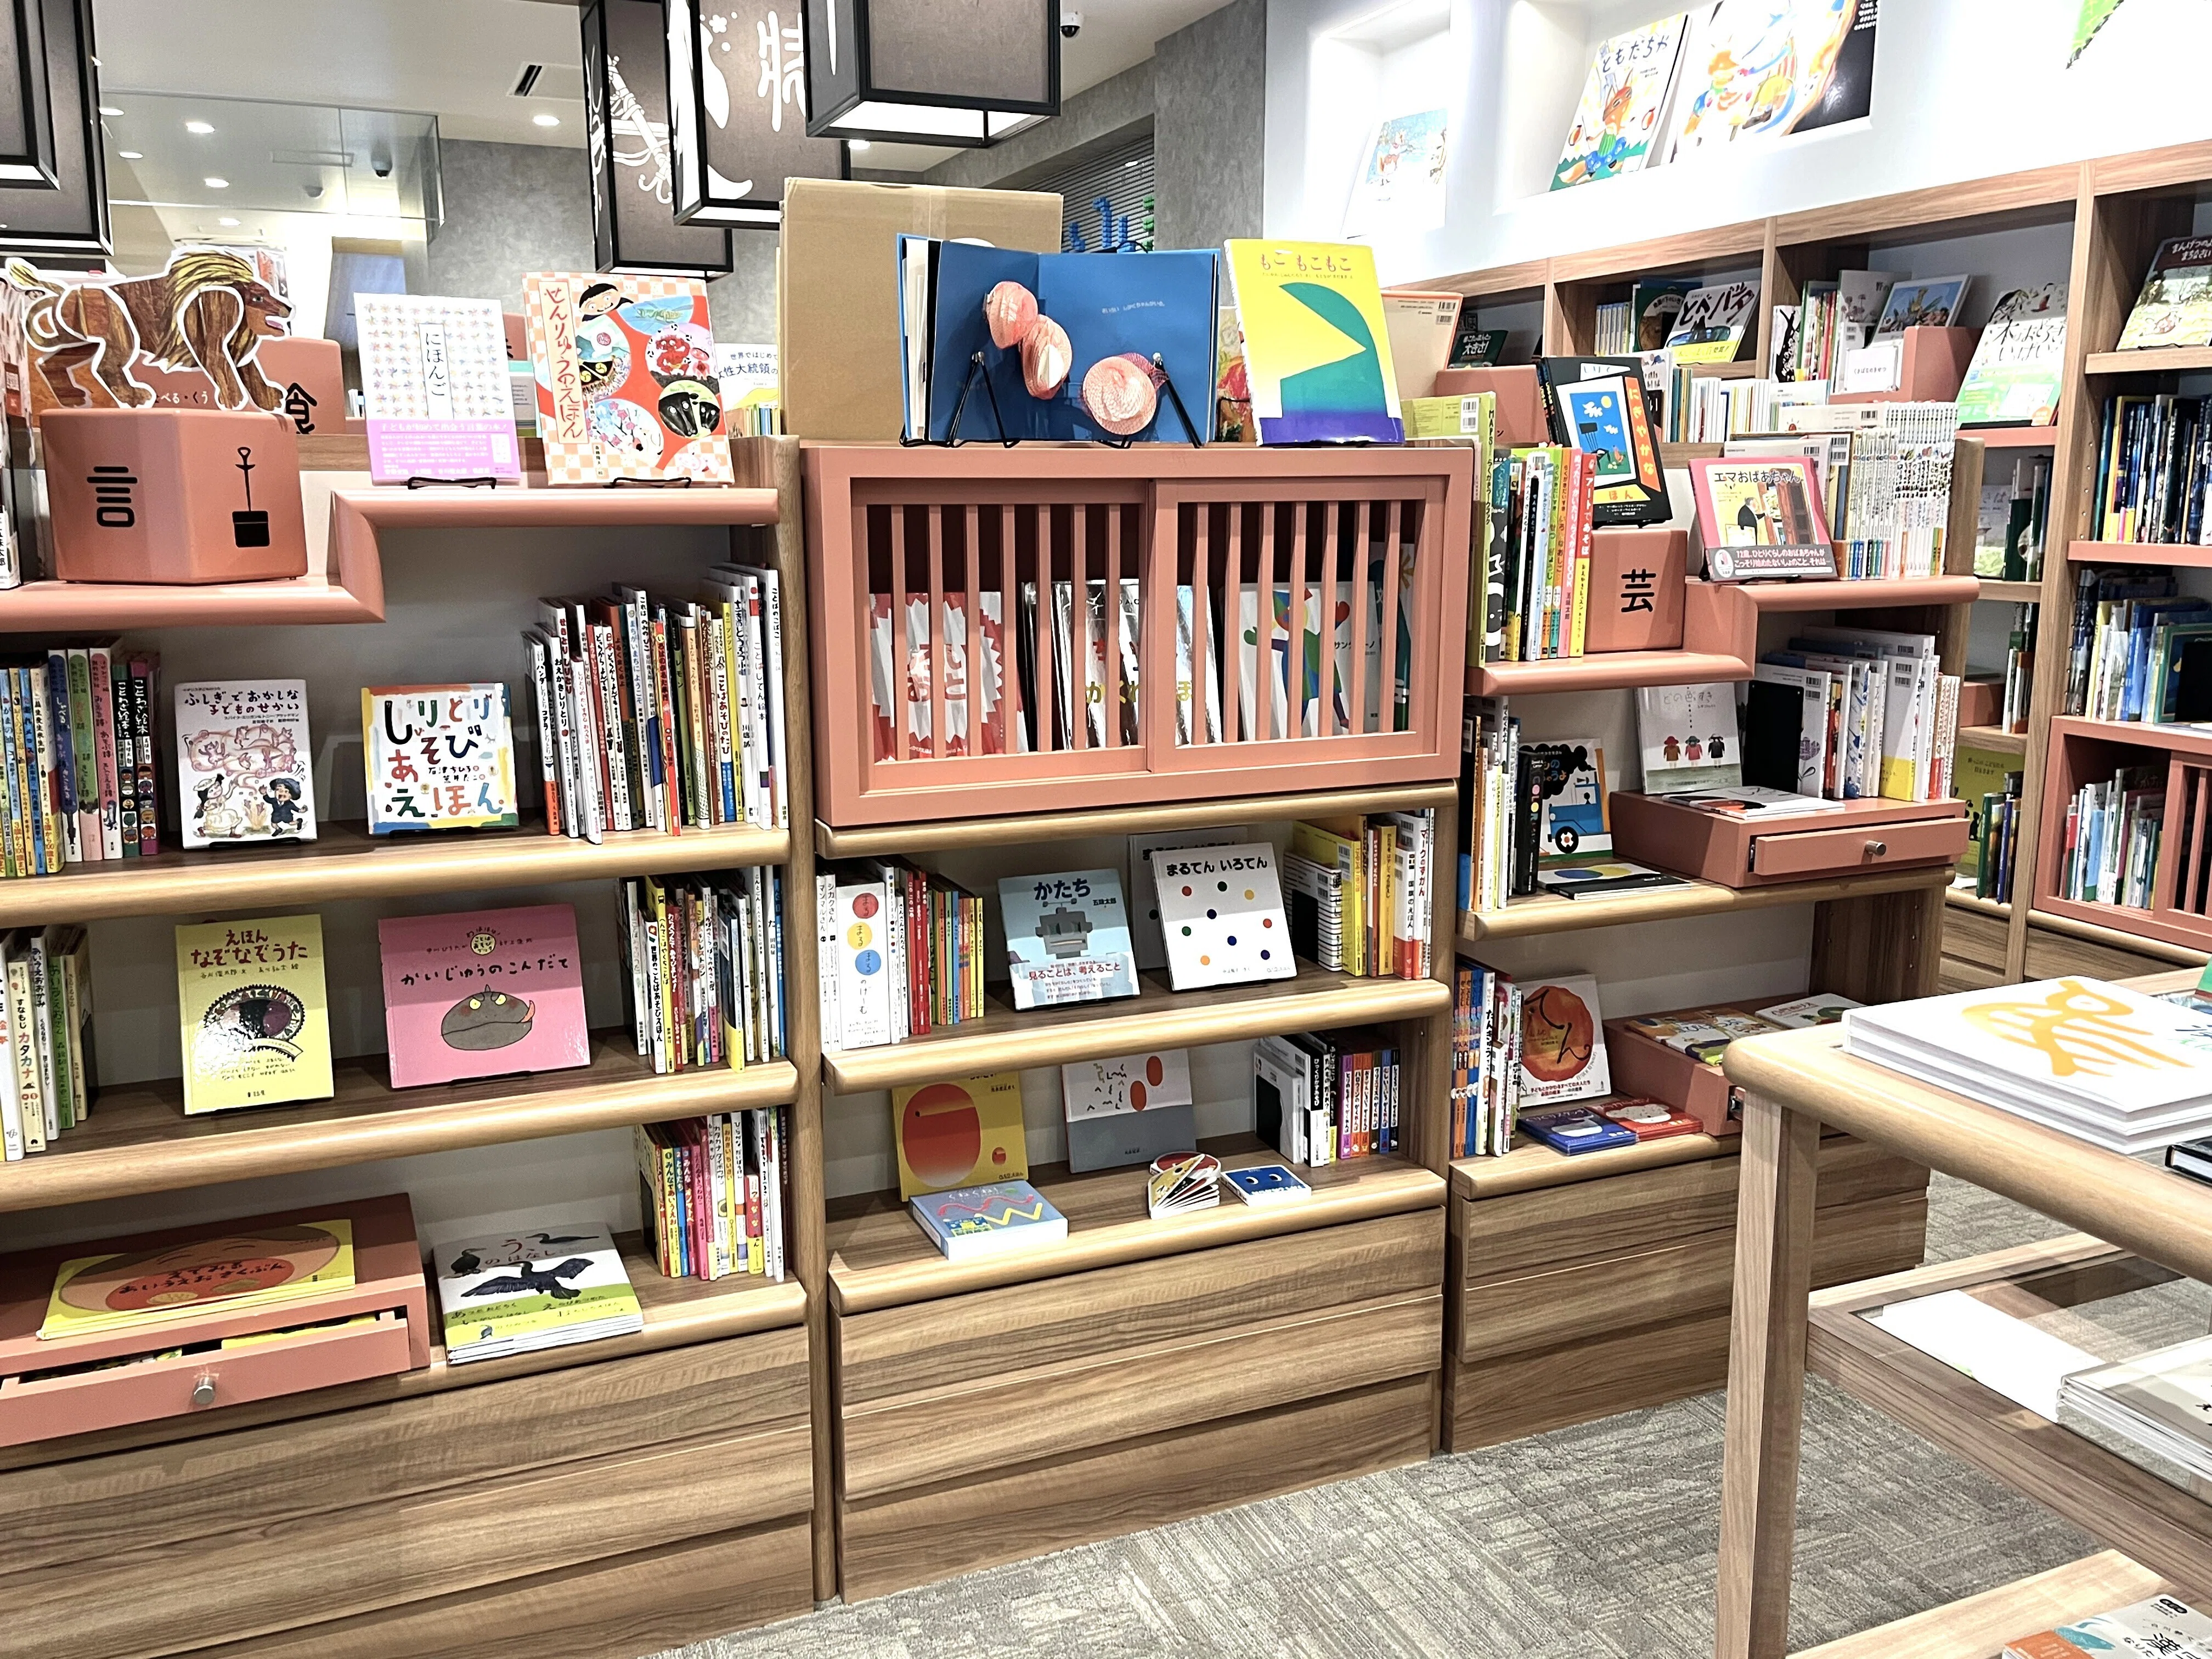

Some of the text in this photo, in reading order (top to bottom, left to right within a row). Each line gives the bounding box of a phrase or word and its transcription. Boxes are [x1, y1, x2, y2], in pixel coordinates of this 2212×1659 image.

[1602, 35, 1669, 73] ともだちや
[1261, 252, 1351, 272] もこ もこもこ
[425, 332, 446, 397] にほんご
[544, 288, 583, 439] せんりゅうのえほん
[286, 382, 317, 434] 食
[1628, 387, 1655, 476] にぎやかな
[1714, 471, 1801, 483] エマおばあちゃん
[1608, 490, 1633, 499] ほん
[1620, 568, 1657, 613] 芸
[605, 633, 614, 651] 日本
[184, 689, 299, 706] ふしぎでおかしな
[555, 658, 568, 727] おえかきしりとり
[210, 702, 300, 715] 子どものせかい
[718, 675, 730, 754] ことばあそびのたび
[393, 782, 503, 818] えほん
[1166, 856, 1268, 877] まるてん いろてん
[827, 882, 836, 923] シカクさん
[1034, 879, 1091, 901] かたち
[225, 929, 269, 947] えほん
[190, 941, 308, 968] なぞなぞうた
[1029, 962, 1122, 980] 見ることは、考えること
[650, 945, 663, 1042] 世界のことばあそびえほん
[16, 998, 35, 1080] すなもじ カタカナ
[500, 1239, 523, 1255] う
